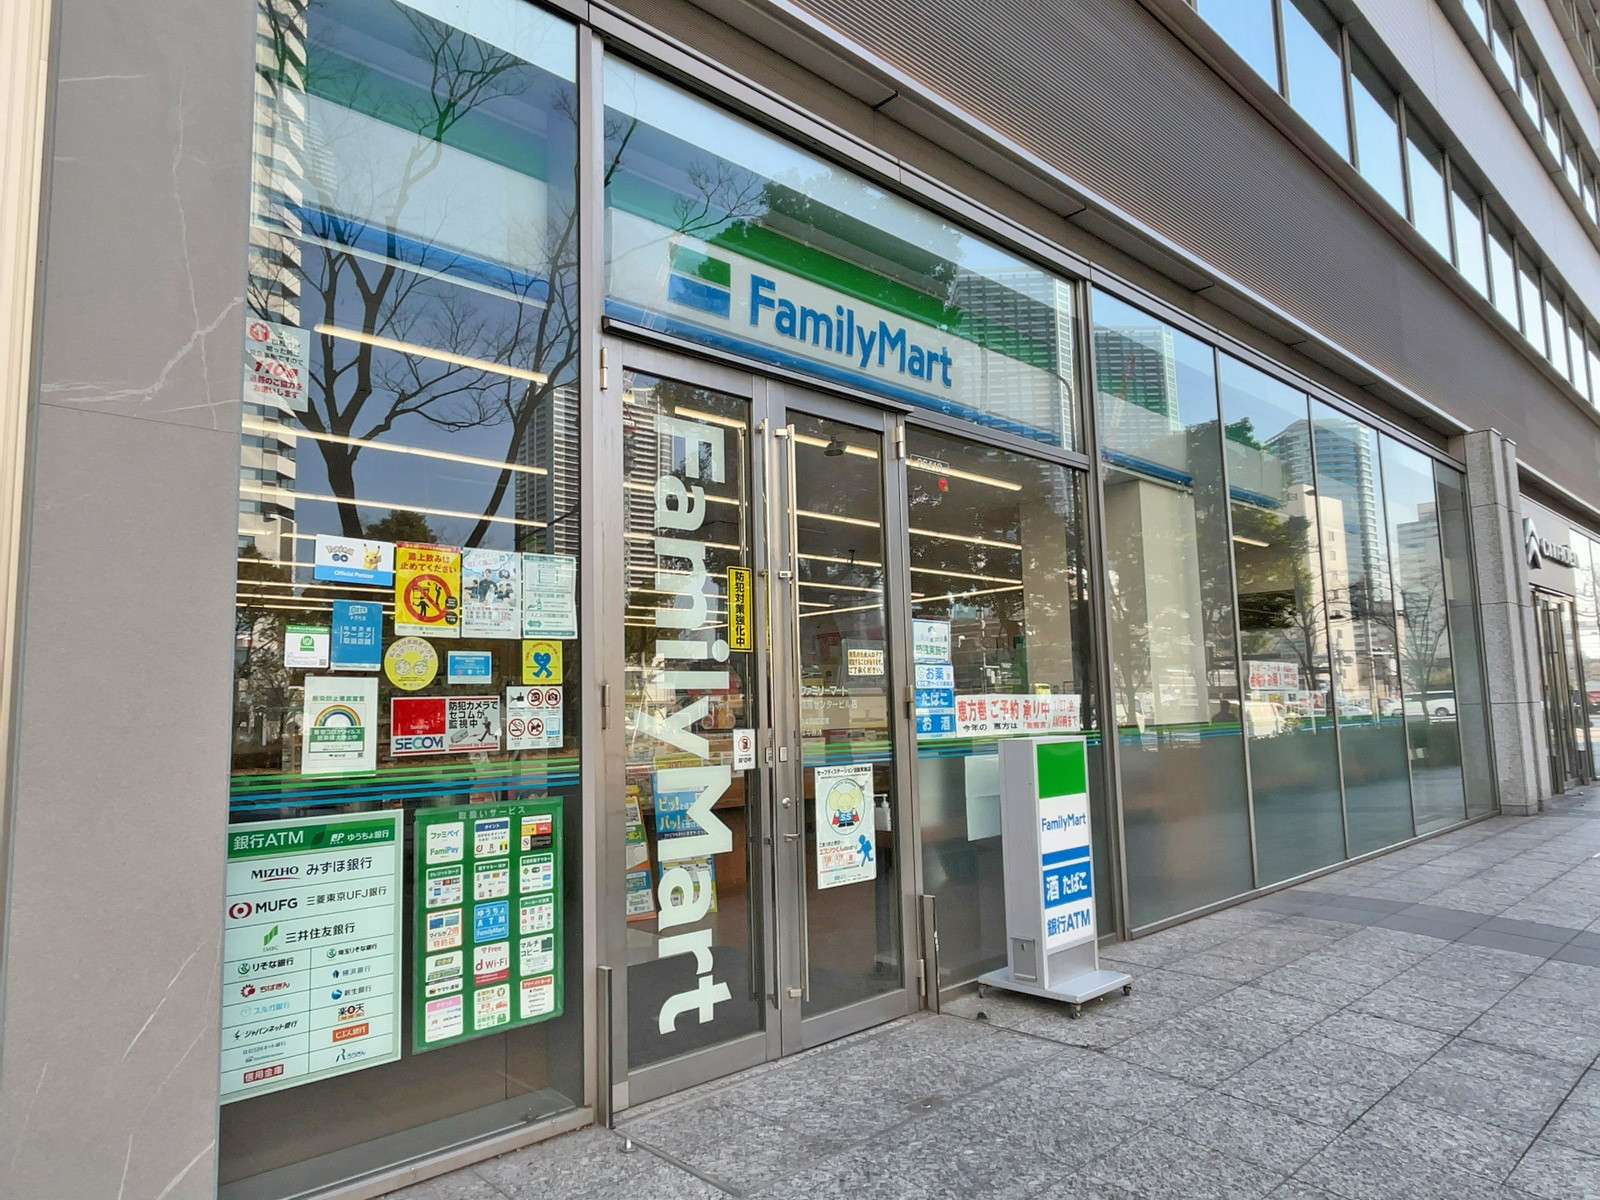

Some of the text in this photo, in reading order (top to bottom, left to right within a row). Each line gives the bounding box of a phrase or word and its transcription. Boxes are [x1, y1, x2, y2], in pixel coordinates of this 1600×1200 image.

[750, 274, 953, 388] FamilyMart
[408, 552, 450, 563] 路上飲みは
[400, 562, 457, 574] 止めてください
[735, 571, 745, 648] 防犯対策強化中
[926, 667, 944, 680] お薬
[801, 686, 848, 696] ファミリーマート
[449, 701, 498, 710] 防犯カメラで
[921, 692, 949, 706] たばこ
[449, 710, 485, 719] セコムが
[958, 699, 987, 722] 恵方巻
[990, 699, 1020, 720] ご予約
[1023, 700, 1050, 720] 承り中
[449, 720, 478, 729] 監視中
[634, 414, 733, 1035] FamilyMart
[922, 716, 950, 732] お酒
[963, 723, 987, 733] 今年の
[993, 722, 1018, 730] 恵方は
[395, 737, 443, 750] SECOM
[458, 806, 525, 820] 取扱いサービス
[840, 813, 852, 822] SS
[1041, 812, 1087, 832] FamilyMart
[233, 830, 304, 850] 銀行ATM
[347, 829, 389, 842] ゆうちょ銀行
[430, 829, 460, 840] ファミペイ
[430, 846, 459, 856] FamiPay
[250, 857, 373, 880] MIZUHO みずほ銀行
[1046, 872, 1088, 901] 酒 たばこ
[255, 886, 388, 914] MUFG 三菱東京UFJ銀行
[477, 907, 505, 917] ゆうちょ
[1047, 909, 1090, 937] 銀行ATM
[285, 922, 356, 943] 三井住友銀行
[477, 927, 505, 936] FamilyMart
[338, 943, 377, 955] 埼玉りそな銀行
[488, 945, 502, 953] Free
[520, 938, 539, 949] マルチ
[521, 949, 539, 957] コピー
[252, 957, 294, 971] りそな銀行
[486, 958, 507, 969] Wi-Fi
[342, 965, 371, 976] 横浜銀行
[260, 981, 290, 993] ちばぎん
[344, 985, 372, 997] 新生銀行
[253, 1002, 290, 1015] スルガ銀行
[244, 1020, 297, 1039] ジャパンネット銀行
[335, 1027, 366, 1040] じぶん銀行
[245, 1067, 283, 1082] 信用金庫
